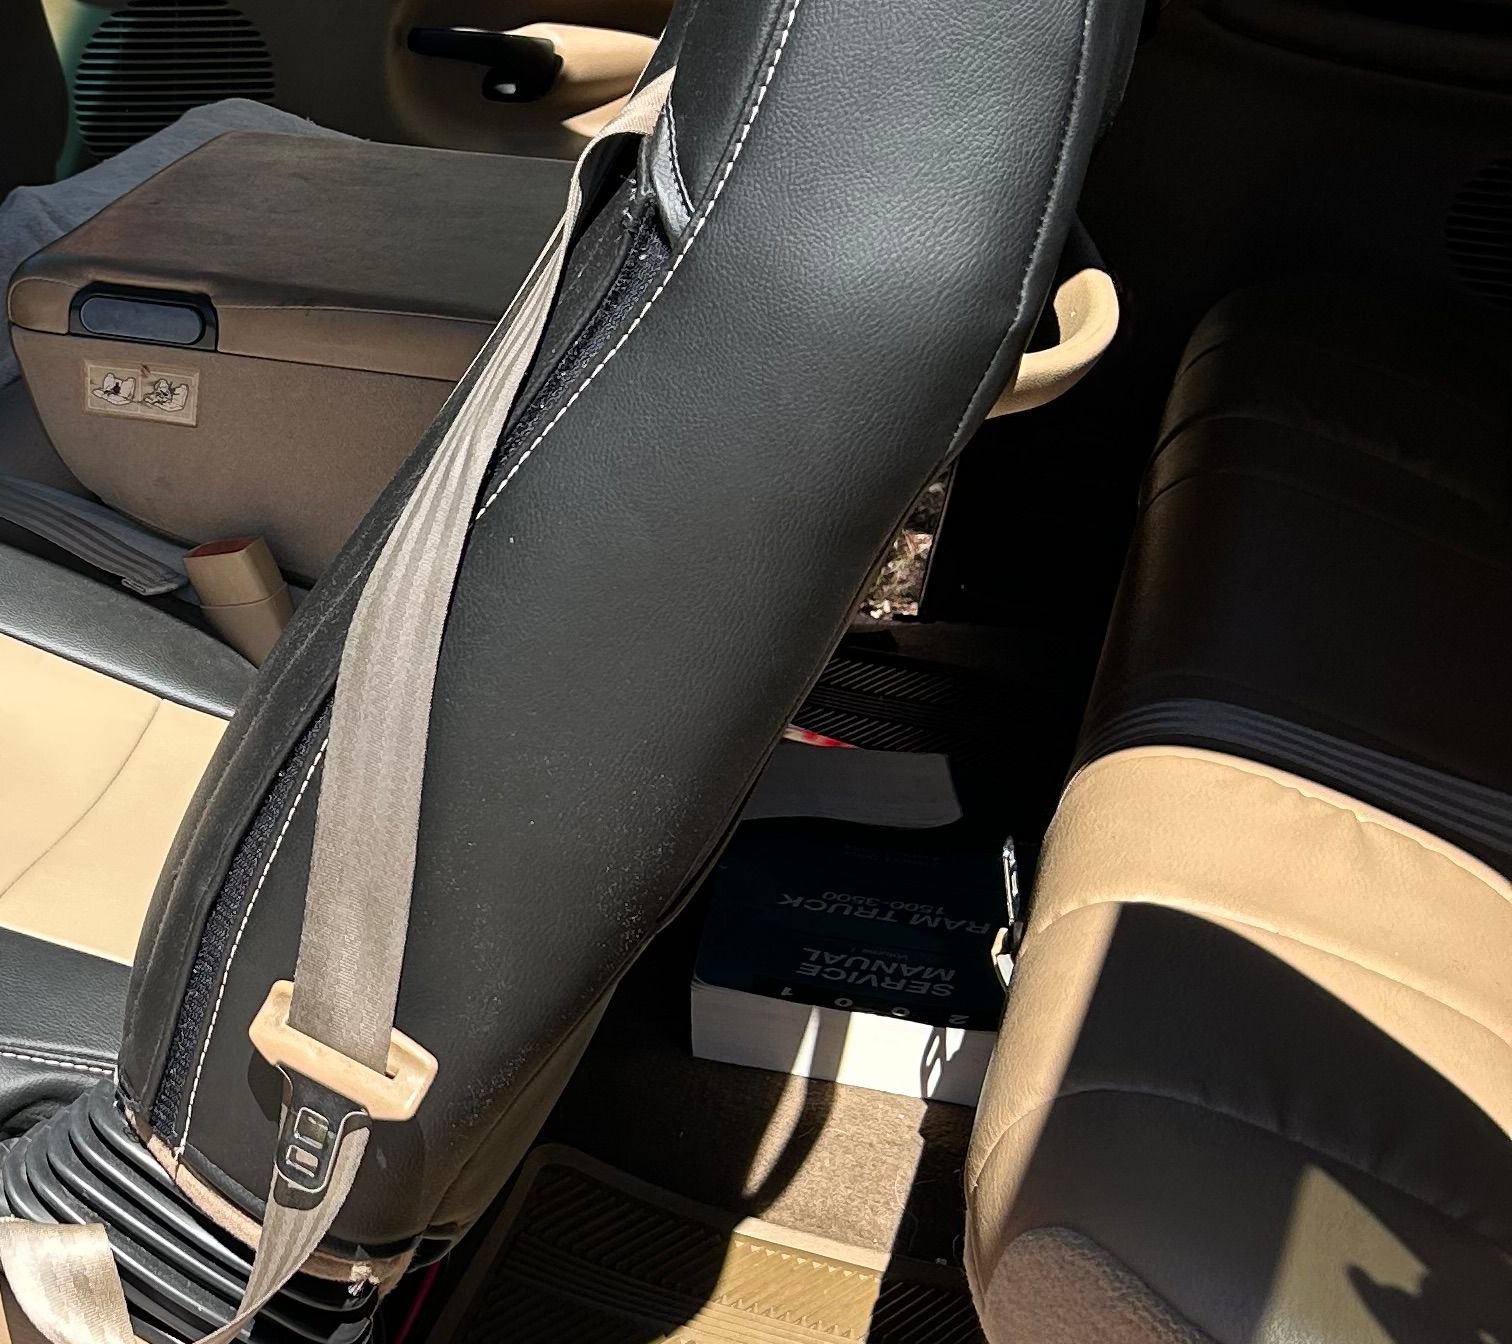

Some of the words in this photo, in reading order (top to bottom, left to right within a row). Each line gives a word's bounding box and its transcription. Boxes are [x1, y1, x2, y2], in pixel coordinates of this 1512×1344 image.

[776, 893, 903, 923] TRUCK
[821, 890, 945, 915] 1500-3500
[909, 911, 992, 935] RAM
[794, 962, 956, 997] SERVICE
[800, 947, 956, 982] MANUAL
